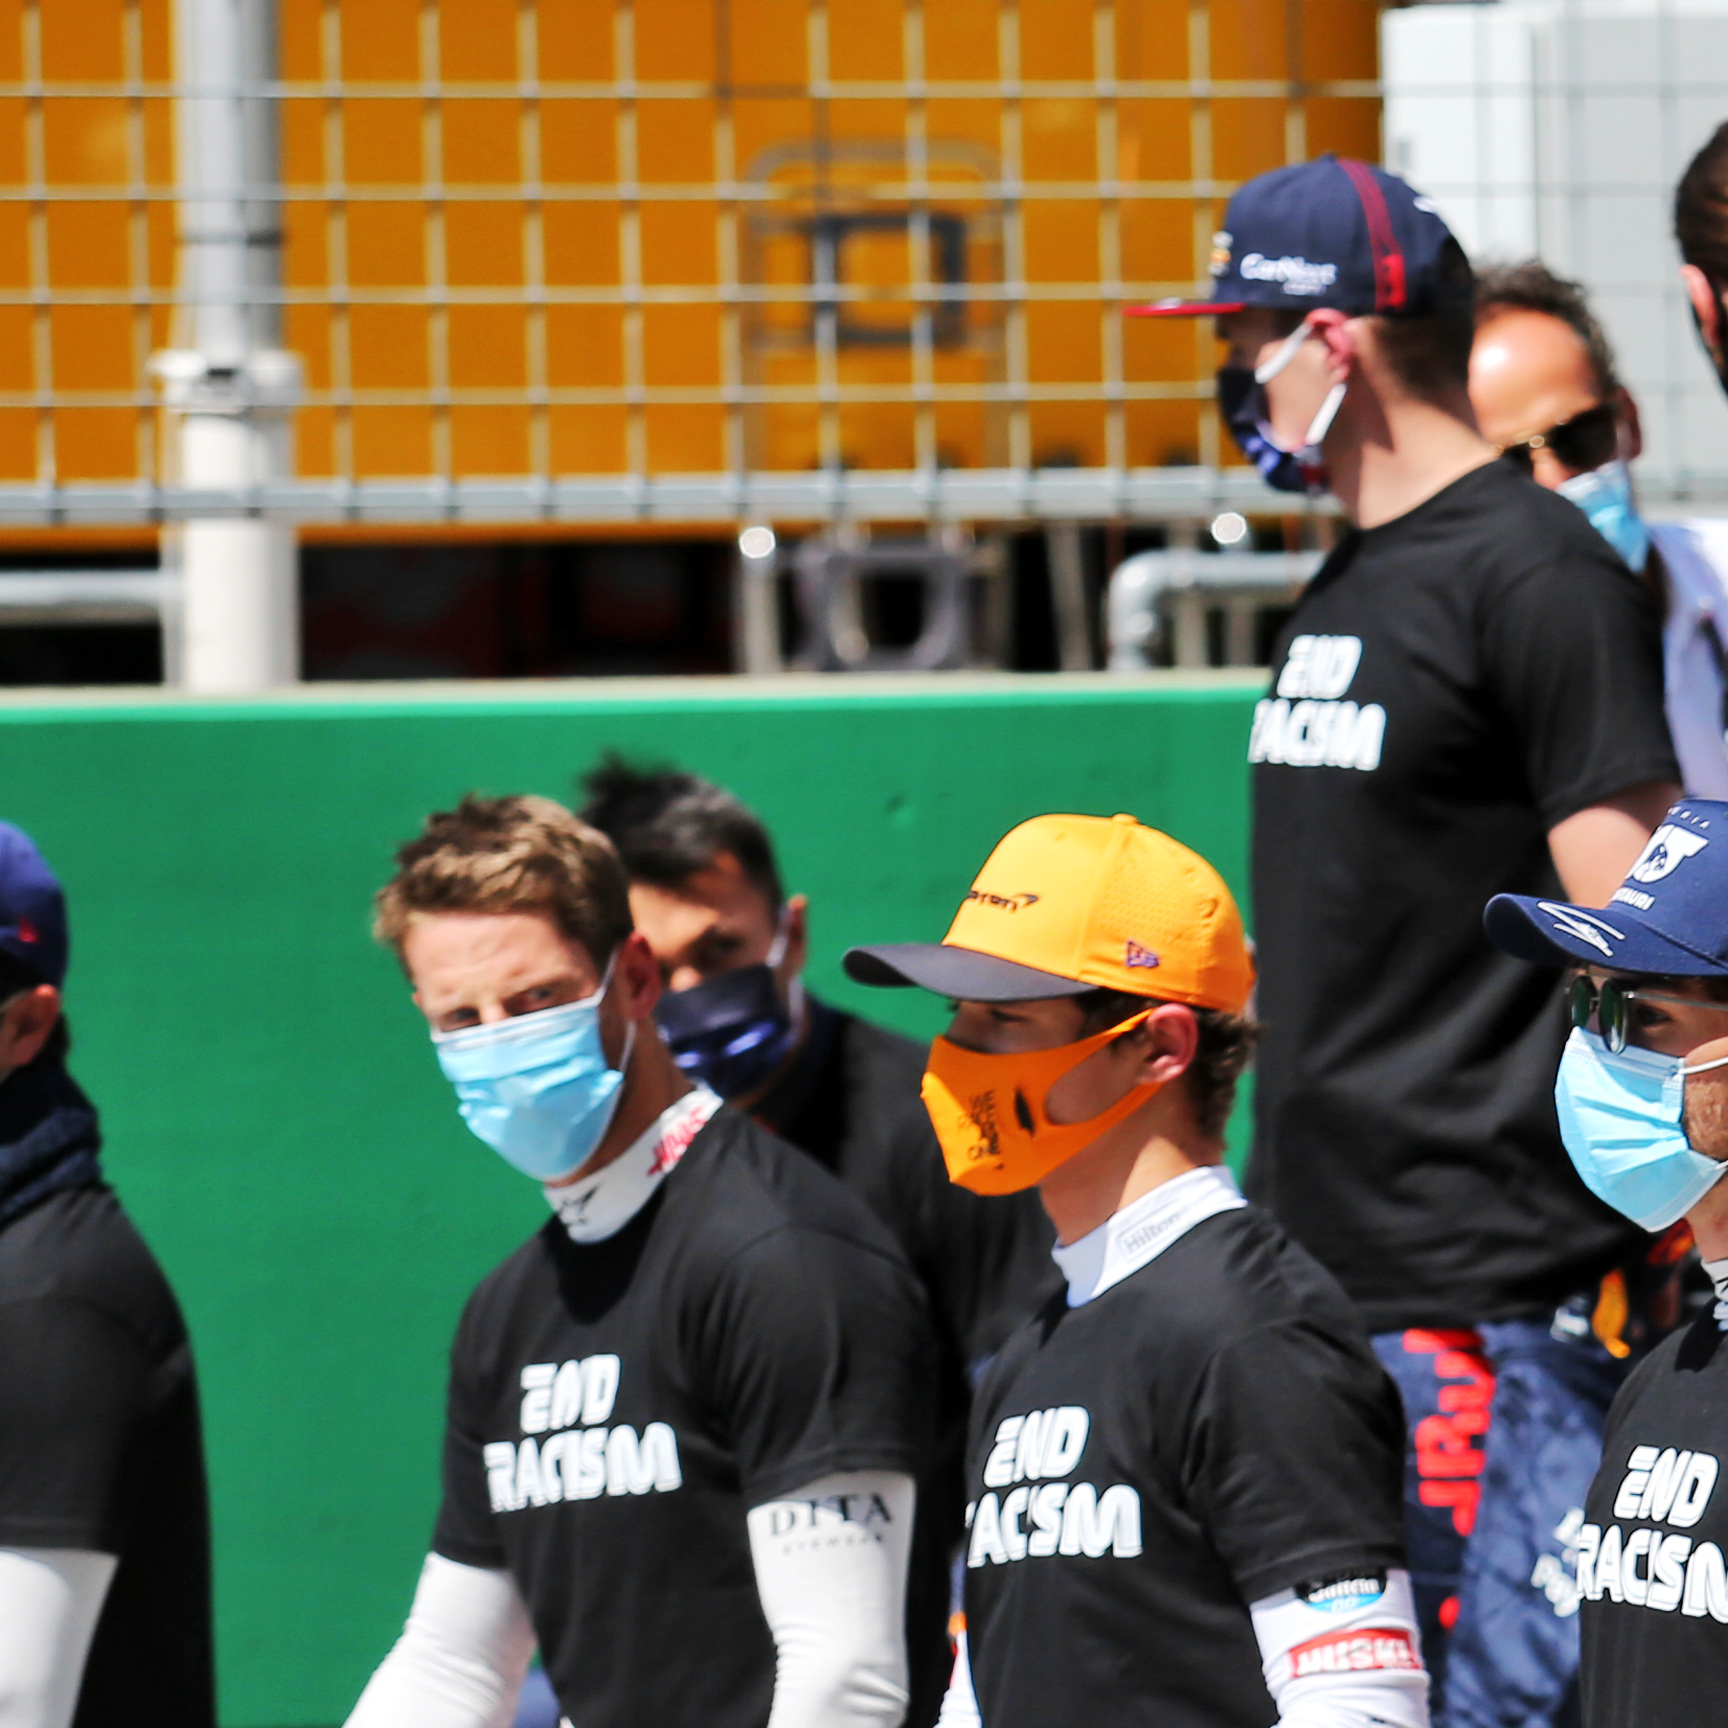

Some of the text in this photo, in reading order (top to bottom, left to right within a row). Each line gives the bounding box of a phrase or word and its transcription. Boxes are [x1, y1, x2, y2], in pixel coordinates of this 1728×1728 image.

[1273, 634, 1363, 699] END
[519, 1353, 620, 1434] END
[483, 1421, 683, 1514] RACISM
[983, 1405, 1090, 1487] END
[770, 1492, 893, 1537] DITA
[1612, 1444, 1719, 1533] END
